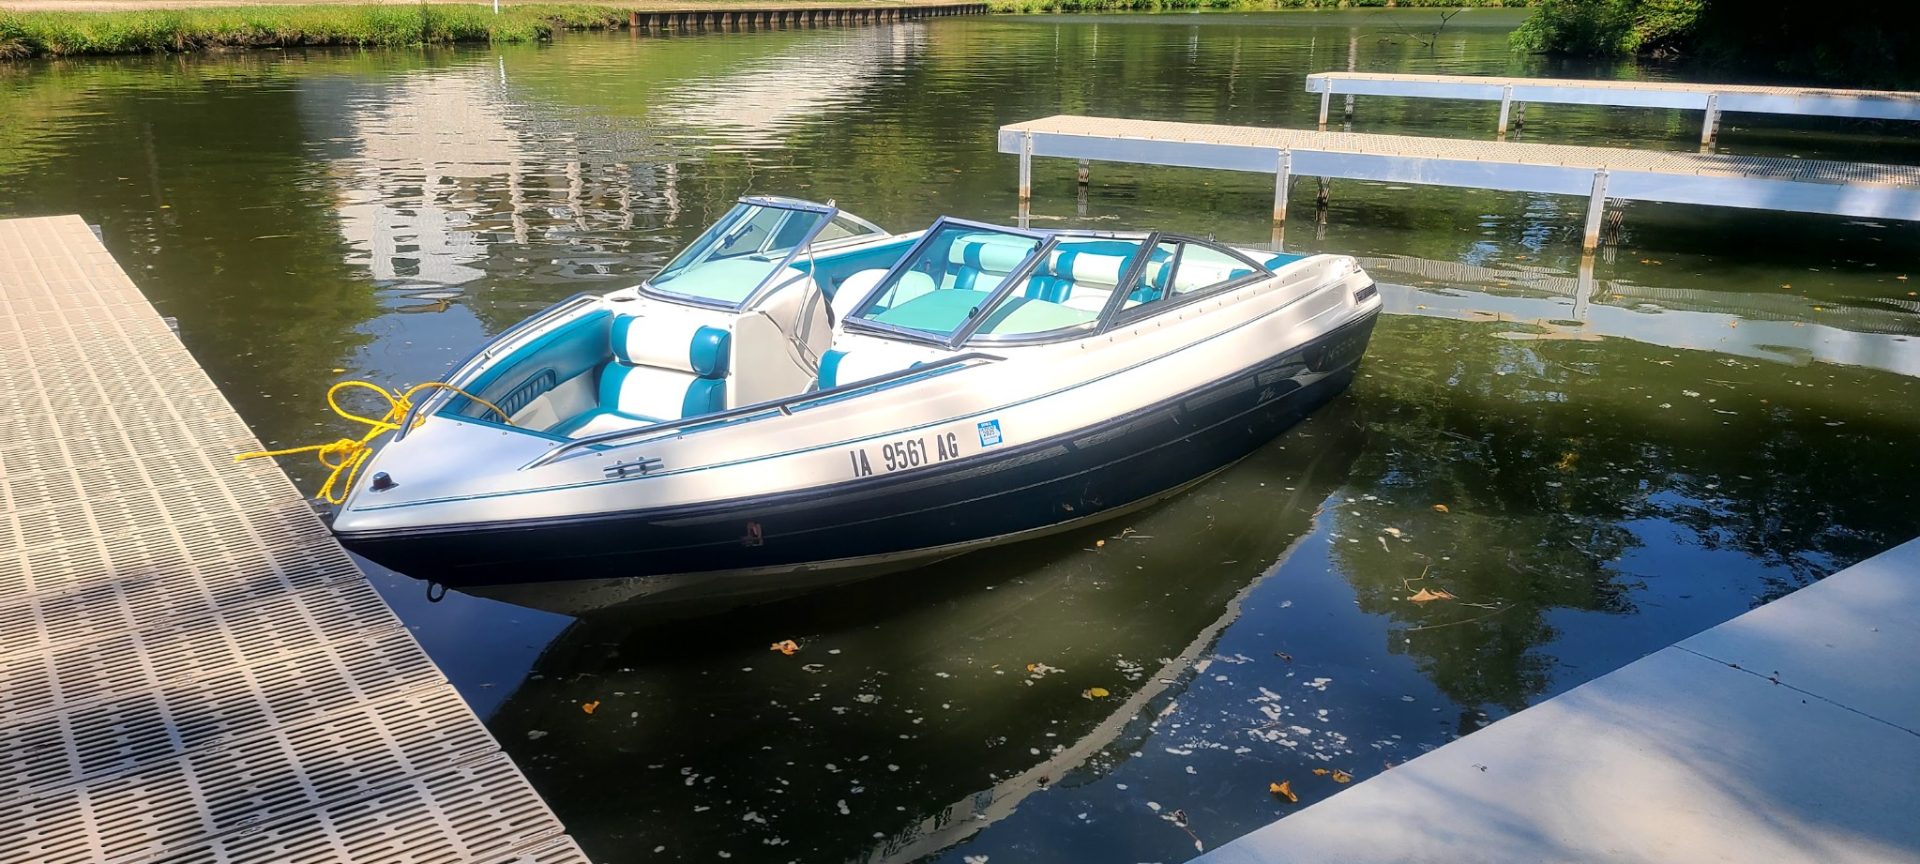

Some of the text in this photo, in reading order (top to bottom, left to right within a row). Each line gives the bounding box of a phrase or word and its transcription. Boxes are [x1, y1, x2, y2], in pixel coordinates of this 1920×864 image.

[850, 432, 959, 477] IA 9561 AG
